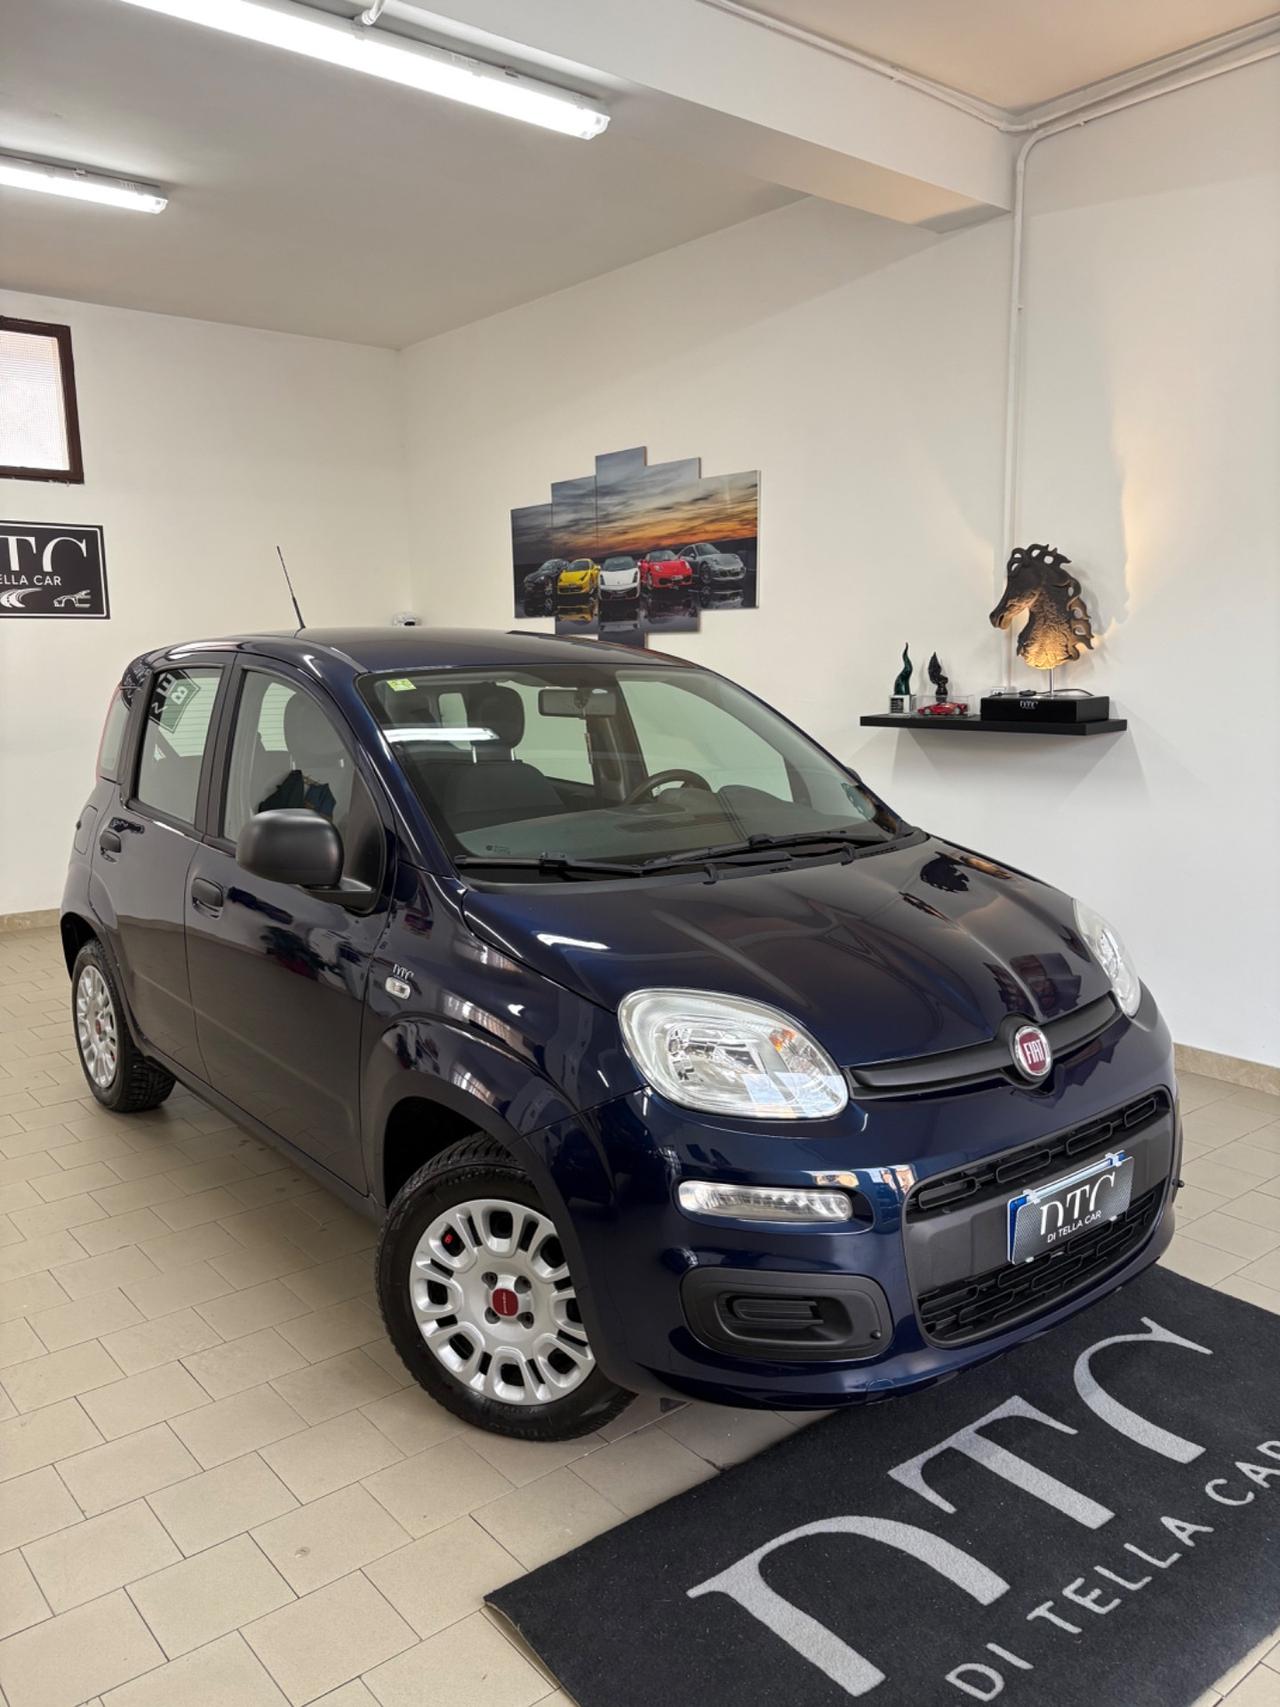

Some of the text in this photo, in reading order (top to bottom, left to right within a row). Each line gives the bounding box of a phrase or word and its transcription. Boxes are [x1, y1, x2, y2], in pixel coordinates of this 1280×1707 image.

[33, 575, 62, 586] CAR
[1023, 1039, 1045, 1064] FIAT
[1047, 1210, 1102, 1243] DI TELLA CAR
[944, 1643, 1034, 1702] DI
[1026, 1515, 1214, 1634] TELLA
